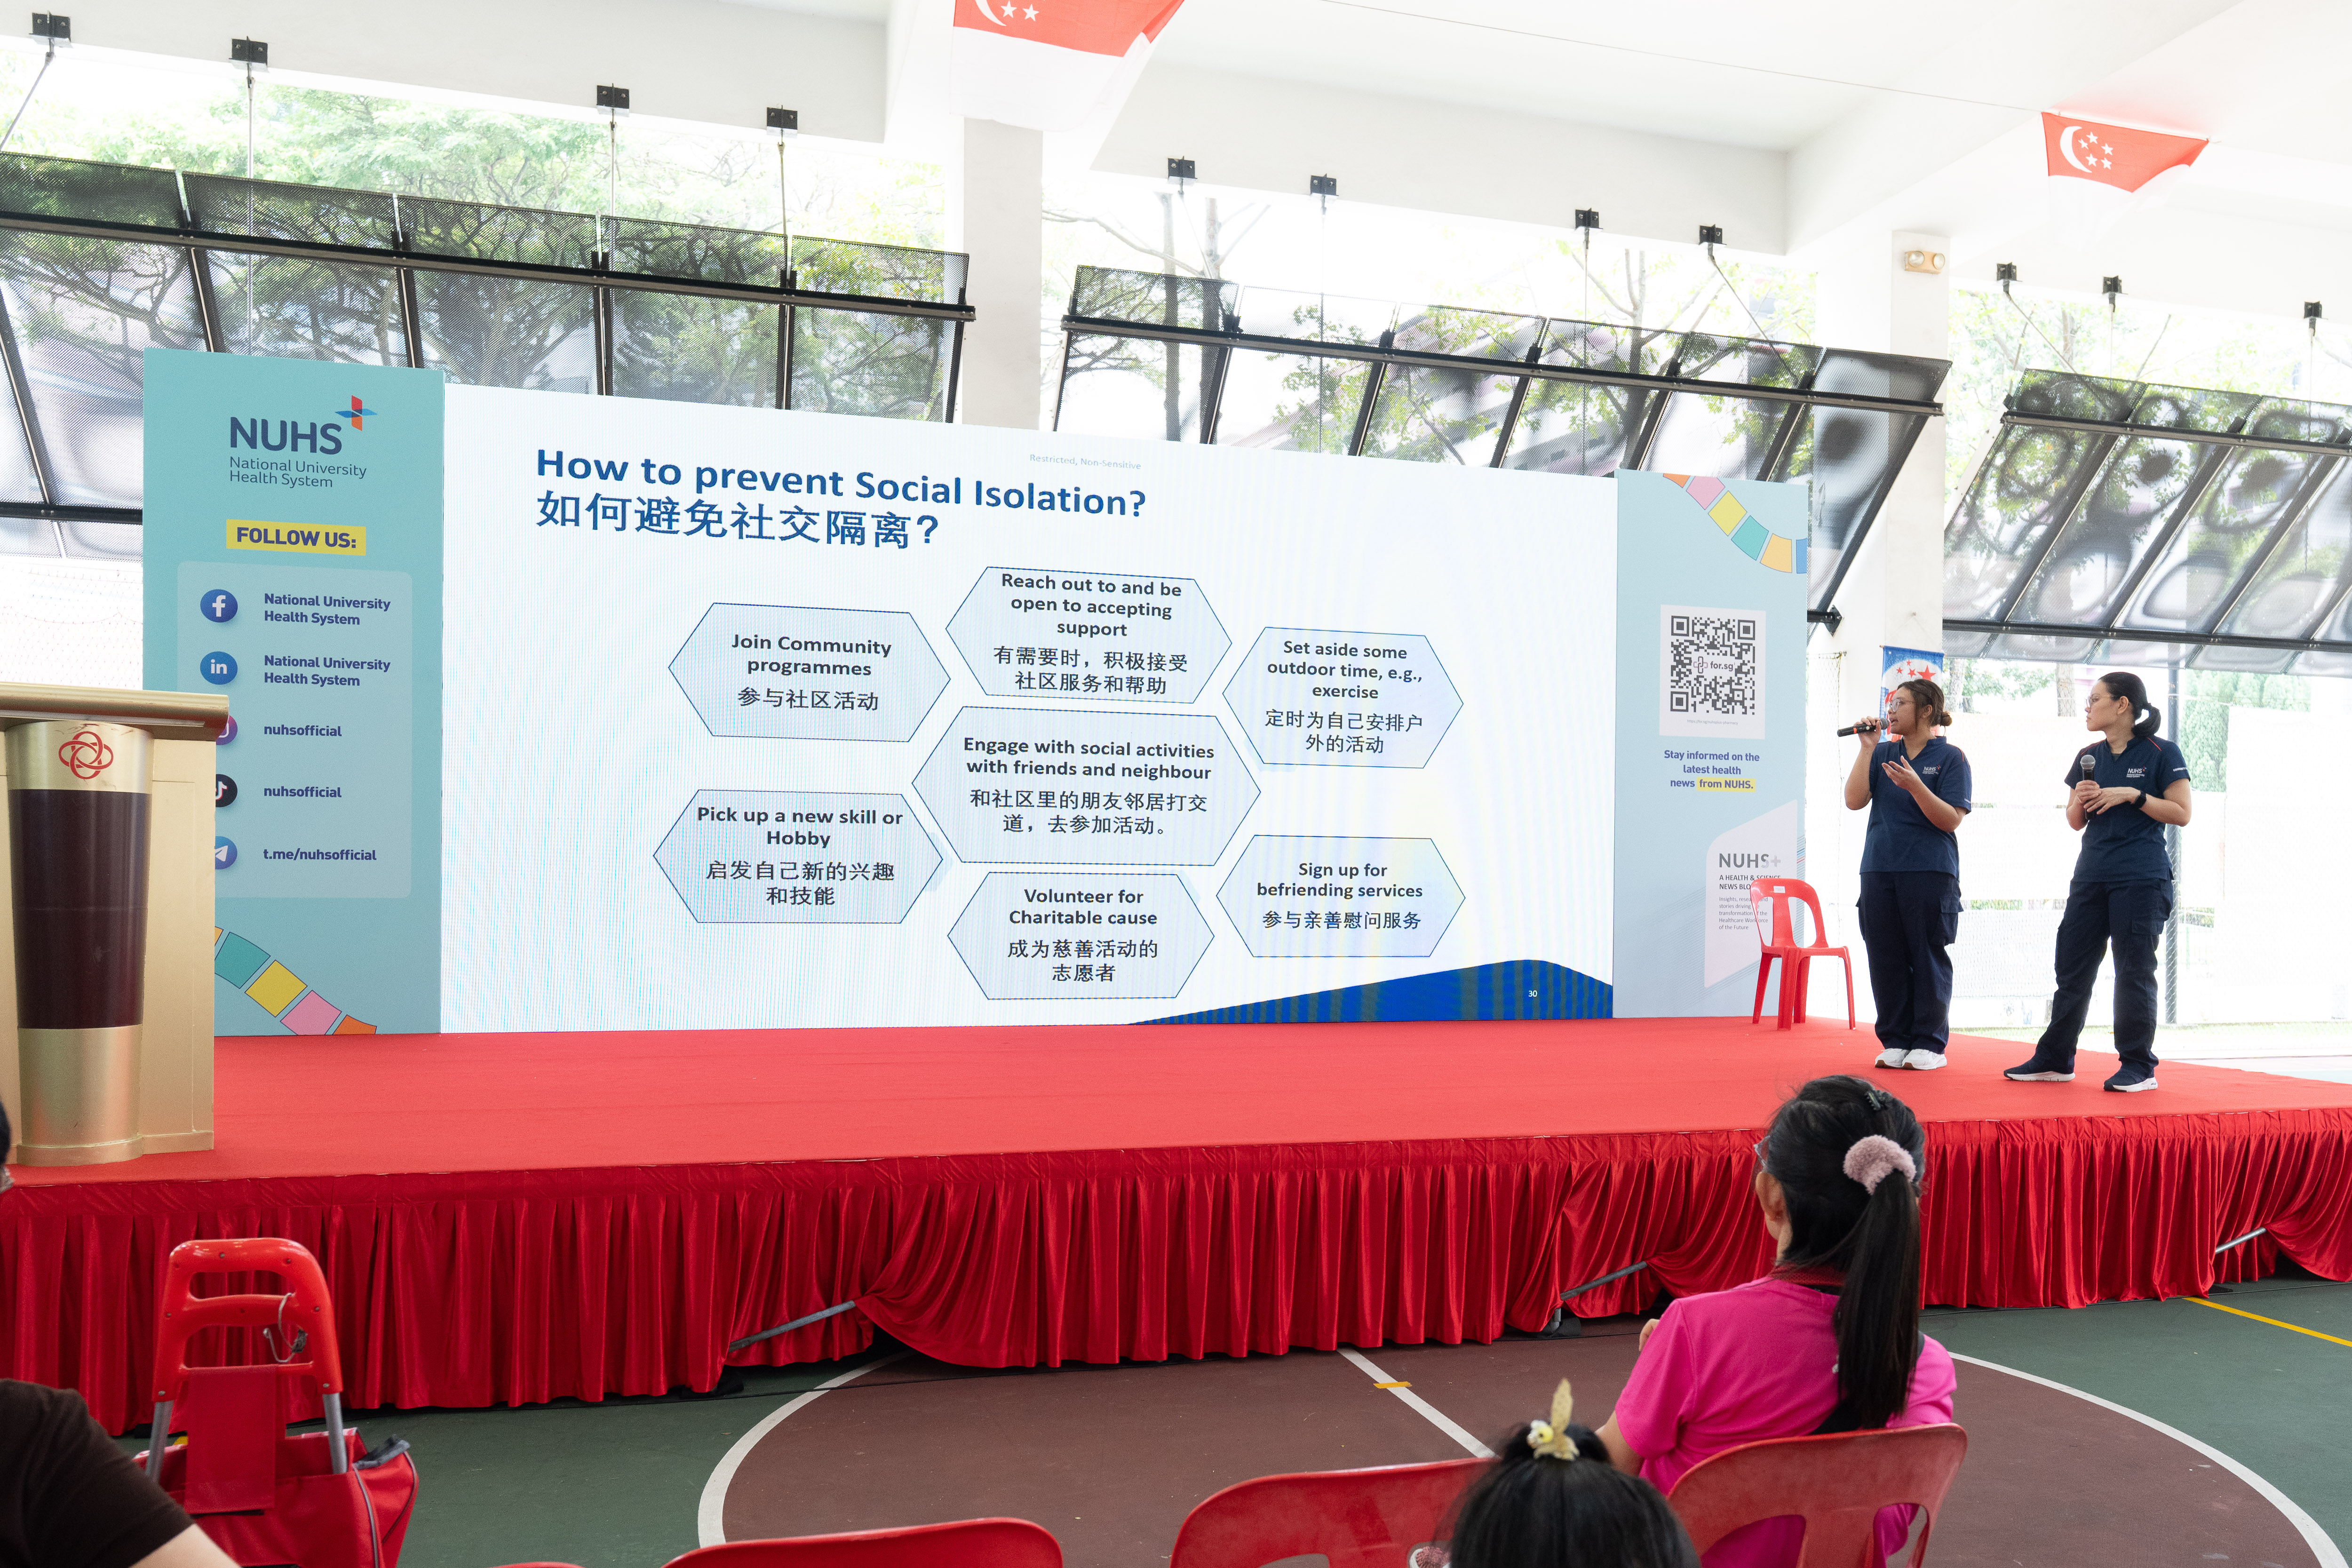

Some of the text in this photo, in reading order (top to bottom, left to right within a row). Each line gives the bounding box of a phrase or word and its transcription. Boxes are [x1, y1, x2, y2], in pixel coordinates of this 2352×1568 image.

[230, 417, 342, 455] NUHS
[230, 456, 367, 479] National University
[1030, 454, 1141, 470] Restricted, Non-Sensitive
[230, 470, 333, 488] Health System
[538, 449, 1146, 517] How to prevent Social Isolation?
[237, 527, 356, 549] FOLLOW US:
[1002, 573, 1182, 597] Reach out to and be
[264, 593, 391, 612] National University
[1011, 599, 1172, 620] open to accepting
[264, 610, 360, 626] Health System
[1057, 622, 1128, 638] support
[732, 634, 892, 658] Join Community
[1283, 640, 1407, 659] Set aside some
[264, 655, 391, 674] National University
[747, 660, 872, 676] programmes
[993, 645, 1188, 672] 有需要时，积极接受
[1710, 661, 1734, 672] for.sg
[264, 672, 360, 687] Health System
[1267, 661, 1422, 683] outdoor time, e.g.,
[1015, 670, 1167, 694] 社区服务和帮助
[738, 687, 879, 711] 参与社区活动
[1312, 685, 1379, 699] exercise
[1264, 709, 1422, 732] 定时为自己安排户
[263, 724, 342, 737] nuhsofficial
[964, 737, 1215, 759] Engage with social activities
[1305, 734, 1384, 754] 外的活动
[1664, 750, 1685, 761] Stay
[1687, 750, 1730, 761] informed
[1745, 753, 1760, 762] the
[966, 759, 1211, 781] with friends and neighbour
[1683, 765, 1741, 775] latest health
[263, 785, 342, 799] nuhsofficial
[1670, 779, 1754, 789] news from NUHS.
[970, 788, 1207, 812] 和社区里的朋友邻居打交
[697, 807, 903, 825] Pick up a new skill or
[1003, 813, 1165, 835] 道，去参加活动。
[767, 831, 831, 849] Hobby
[263, 848, 377, 861] t.me/nuhsofficial
[706, 860, 895, 882] 启发自己新的兴趣
[1298, 862, 1388, 879] Sign up for
[766, 886, 835, 906] 和技能
[1024, 889, 1144, 903] Volunteer for
[1257, 883, 1423, 899] befriending services
[1009, 910, 1158, 925] Charitable cause
[1263, 910, 1422, 930] 参与亲善慰问服务
[1008, 939, 1158, 958] 成为慈善活动的
[1052, 963, 1116, 982] 志愿者
